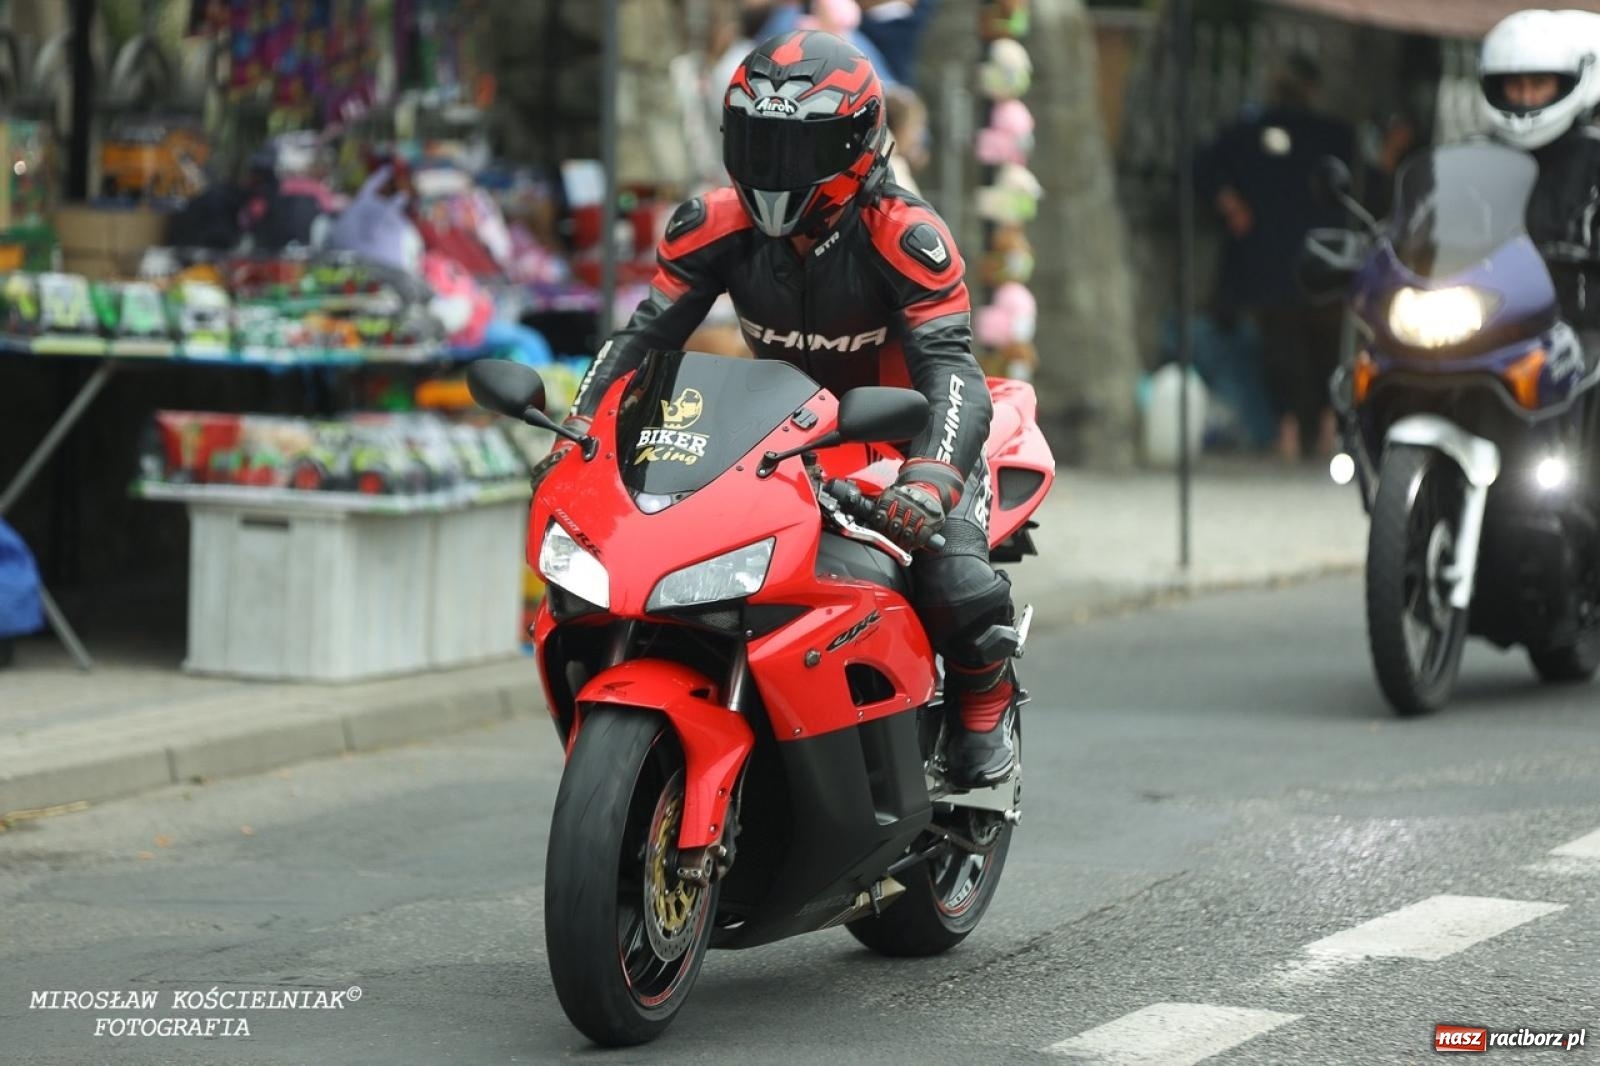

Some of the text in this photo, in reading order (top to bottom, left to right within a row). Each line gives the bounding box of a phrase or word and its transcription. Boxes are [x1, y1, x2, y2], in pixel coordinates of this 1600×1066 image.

[756, 98, 796, 114] Airoh
[740, 317, 888, 352] SHIMA
[635, 429, 707, 457] BIKER
